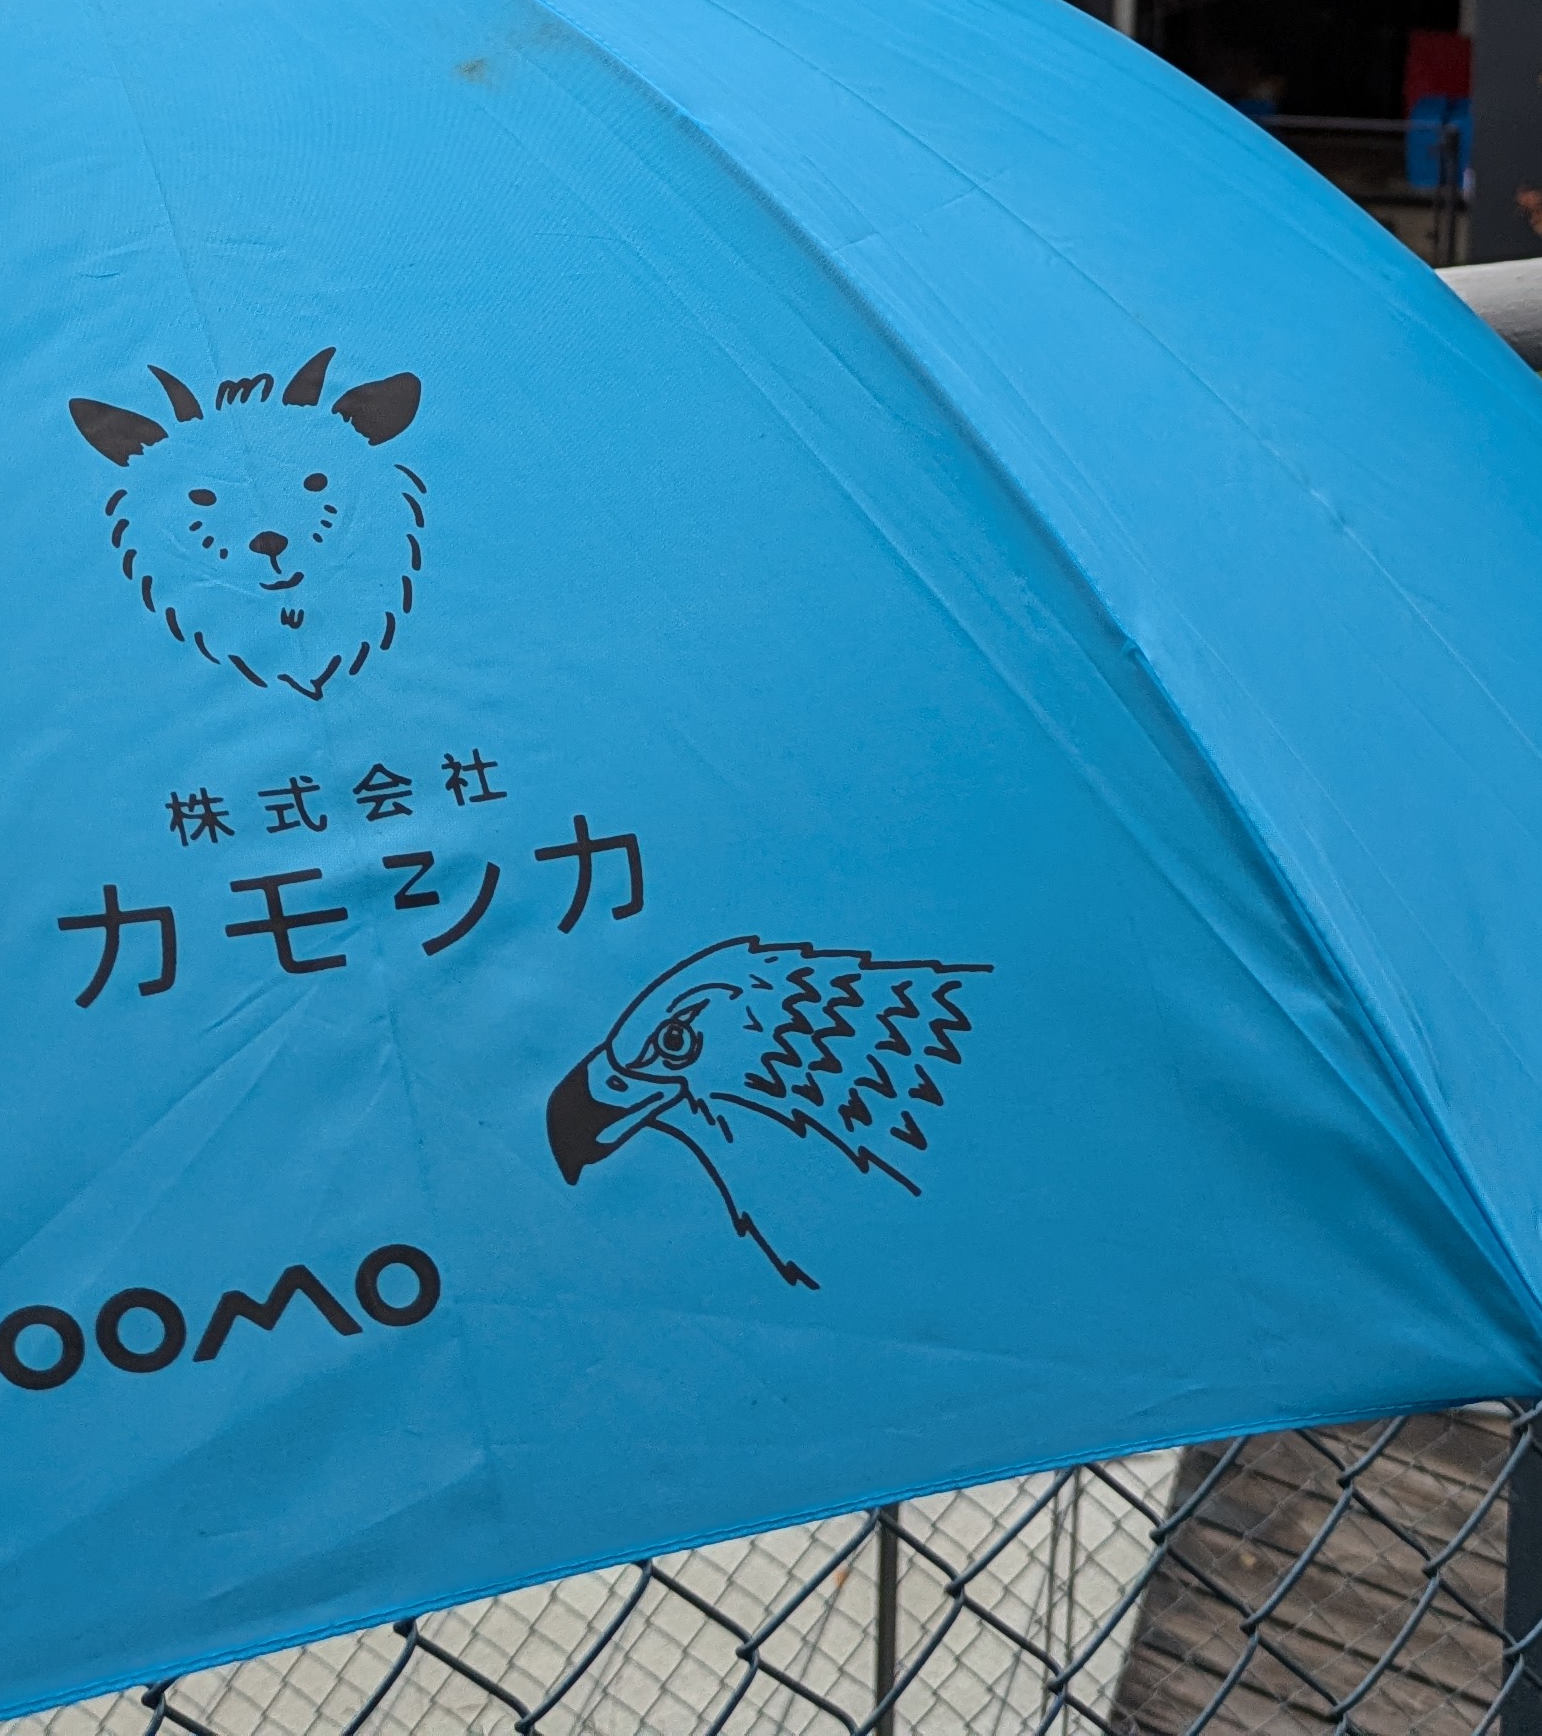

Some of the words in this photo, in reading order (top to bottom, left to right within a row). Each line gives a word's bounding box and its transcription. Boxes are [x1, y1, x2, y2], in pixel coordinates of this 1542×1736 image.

[165, 748, 508, 847] 株式会社
[57, 814, 645, 1009] カモシカ
